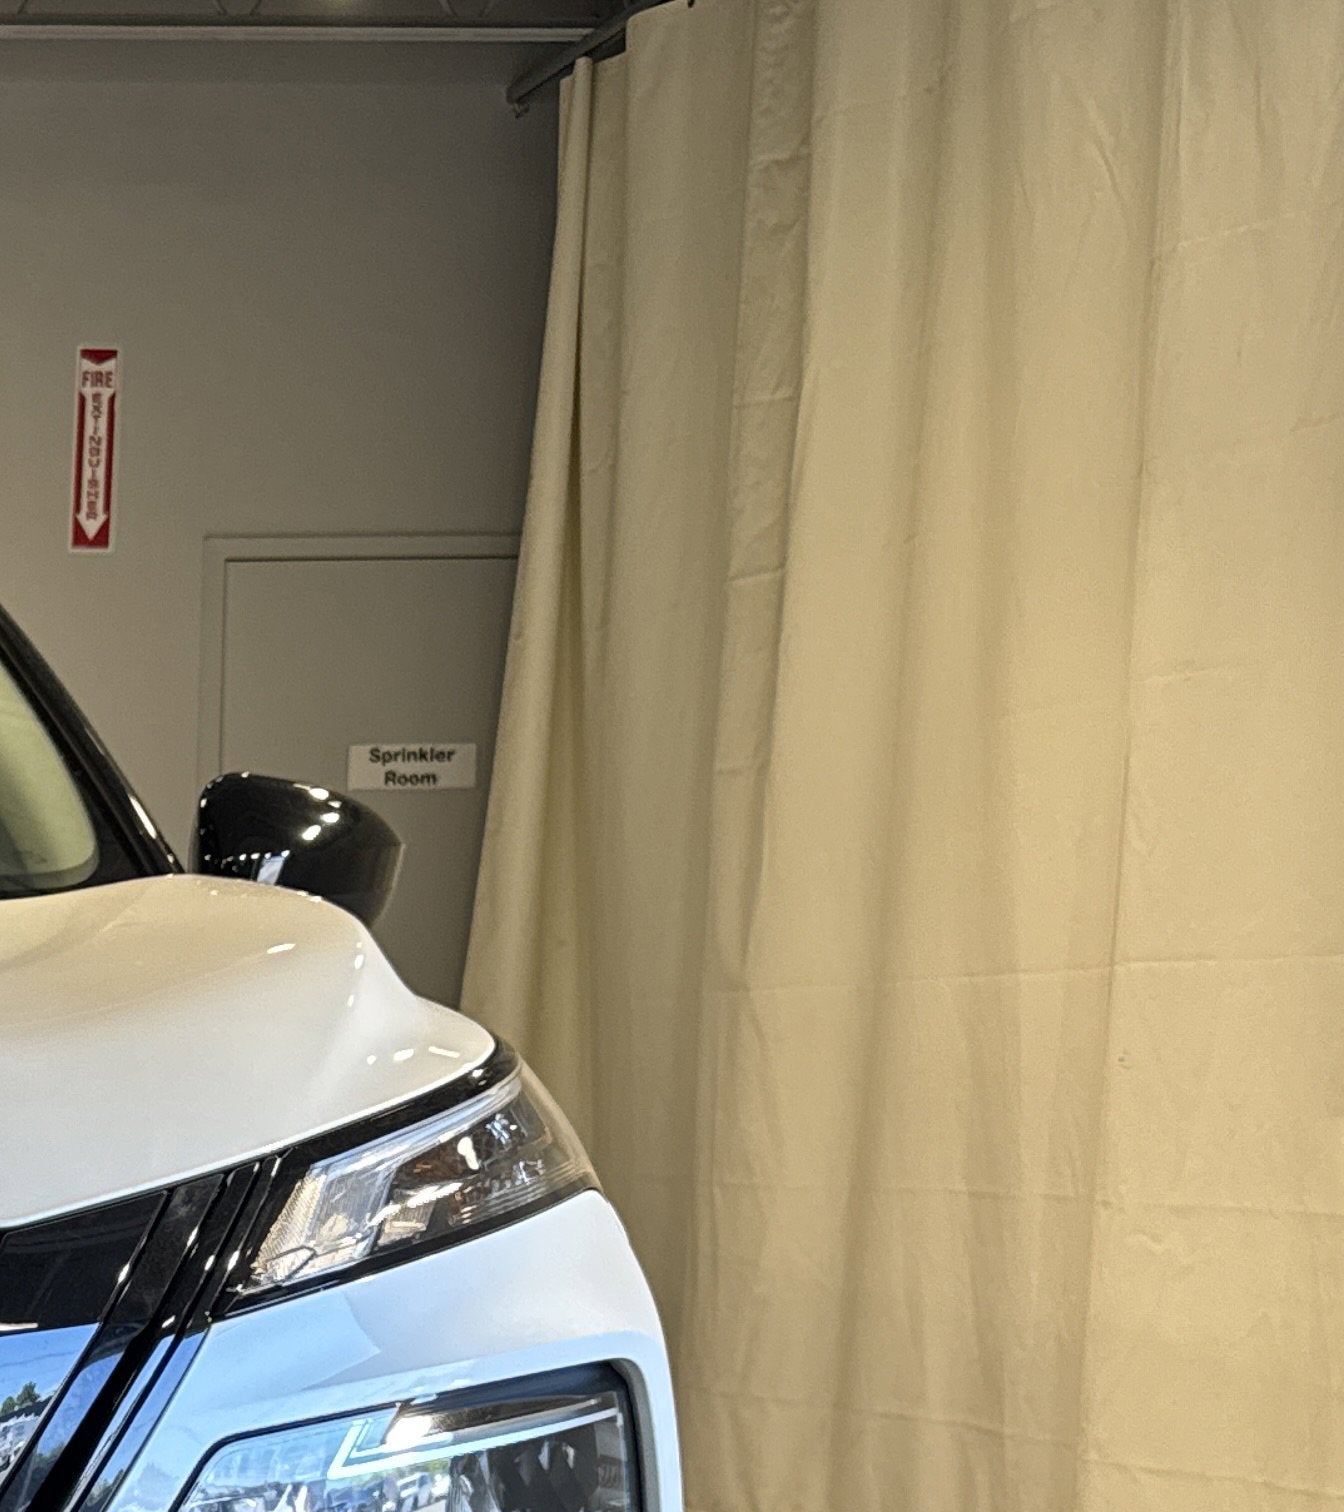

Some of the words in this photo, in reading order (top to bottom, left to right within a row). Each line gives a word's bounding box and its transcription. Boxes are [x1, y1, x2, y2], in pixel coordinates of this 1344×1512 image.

[81, 370, 114, 388] FIRE
[85, 392, 103, 521] EXTINGUISHER
[368, 745, 456, 766] Sprinkler
[384, 770, 438, 786] Room
